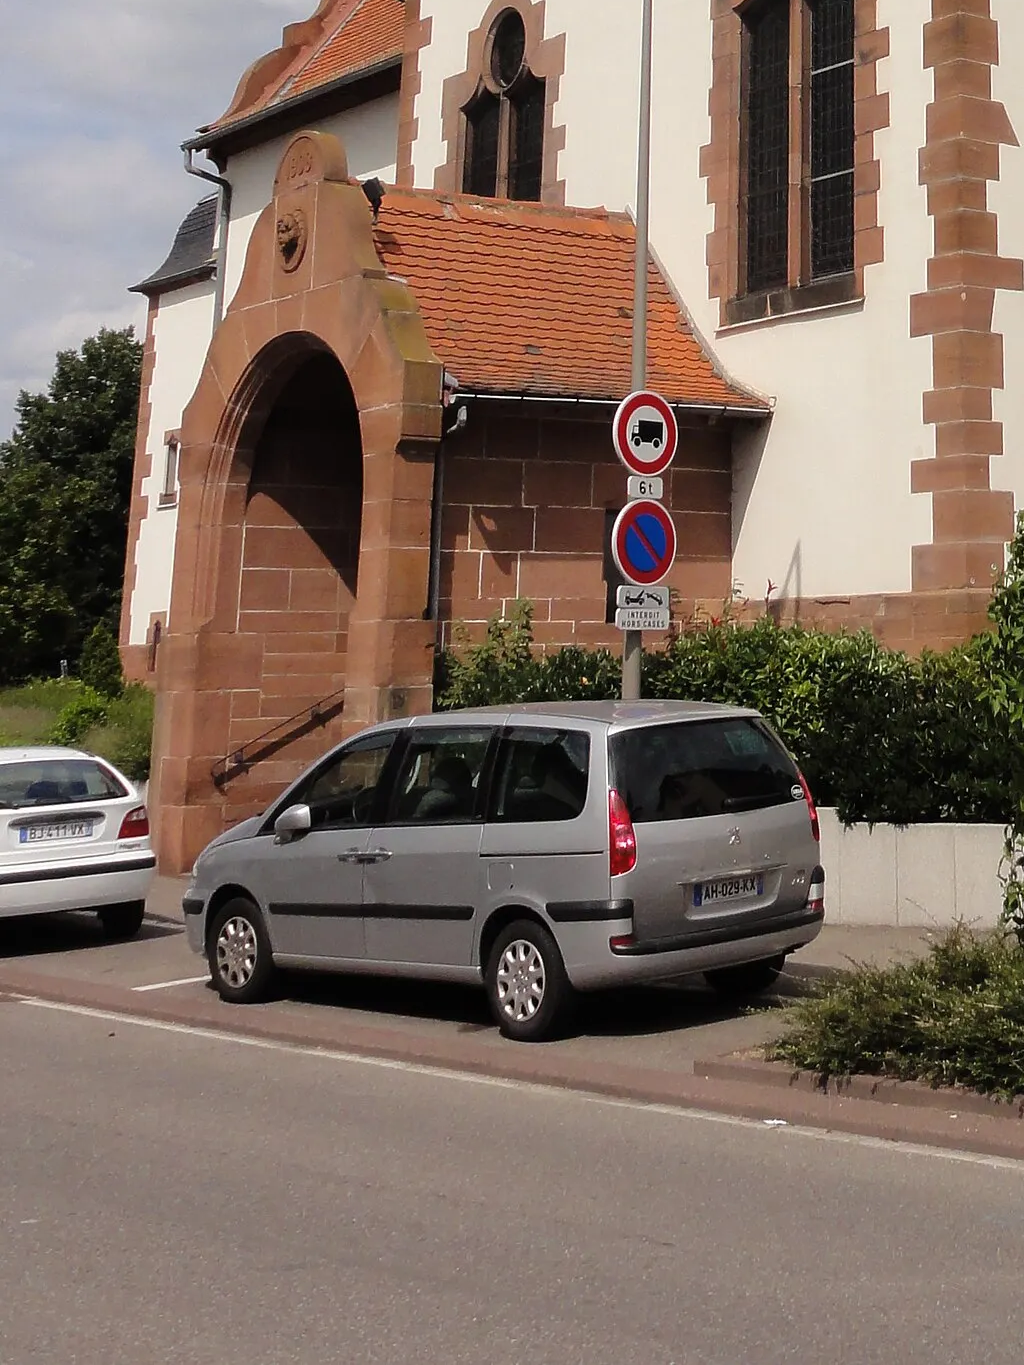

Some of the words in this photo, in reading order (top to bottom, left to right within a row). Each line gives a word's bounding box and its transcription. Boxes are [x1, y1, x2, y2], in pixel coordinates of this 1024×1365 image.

[639, 480, 646, 495] 6
[648, 482, 653, 495] t
[627, 610, 660, 619] INTERDIT
[622, 620, 641, 628] HORS
[643, 619, 665, 628] CASES
[703, 876, 756, 900] AH-029-KX
